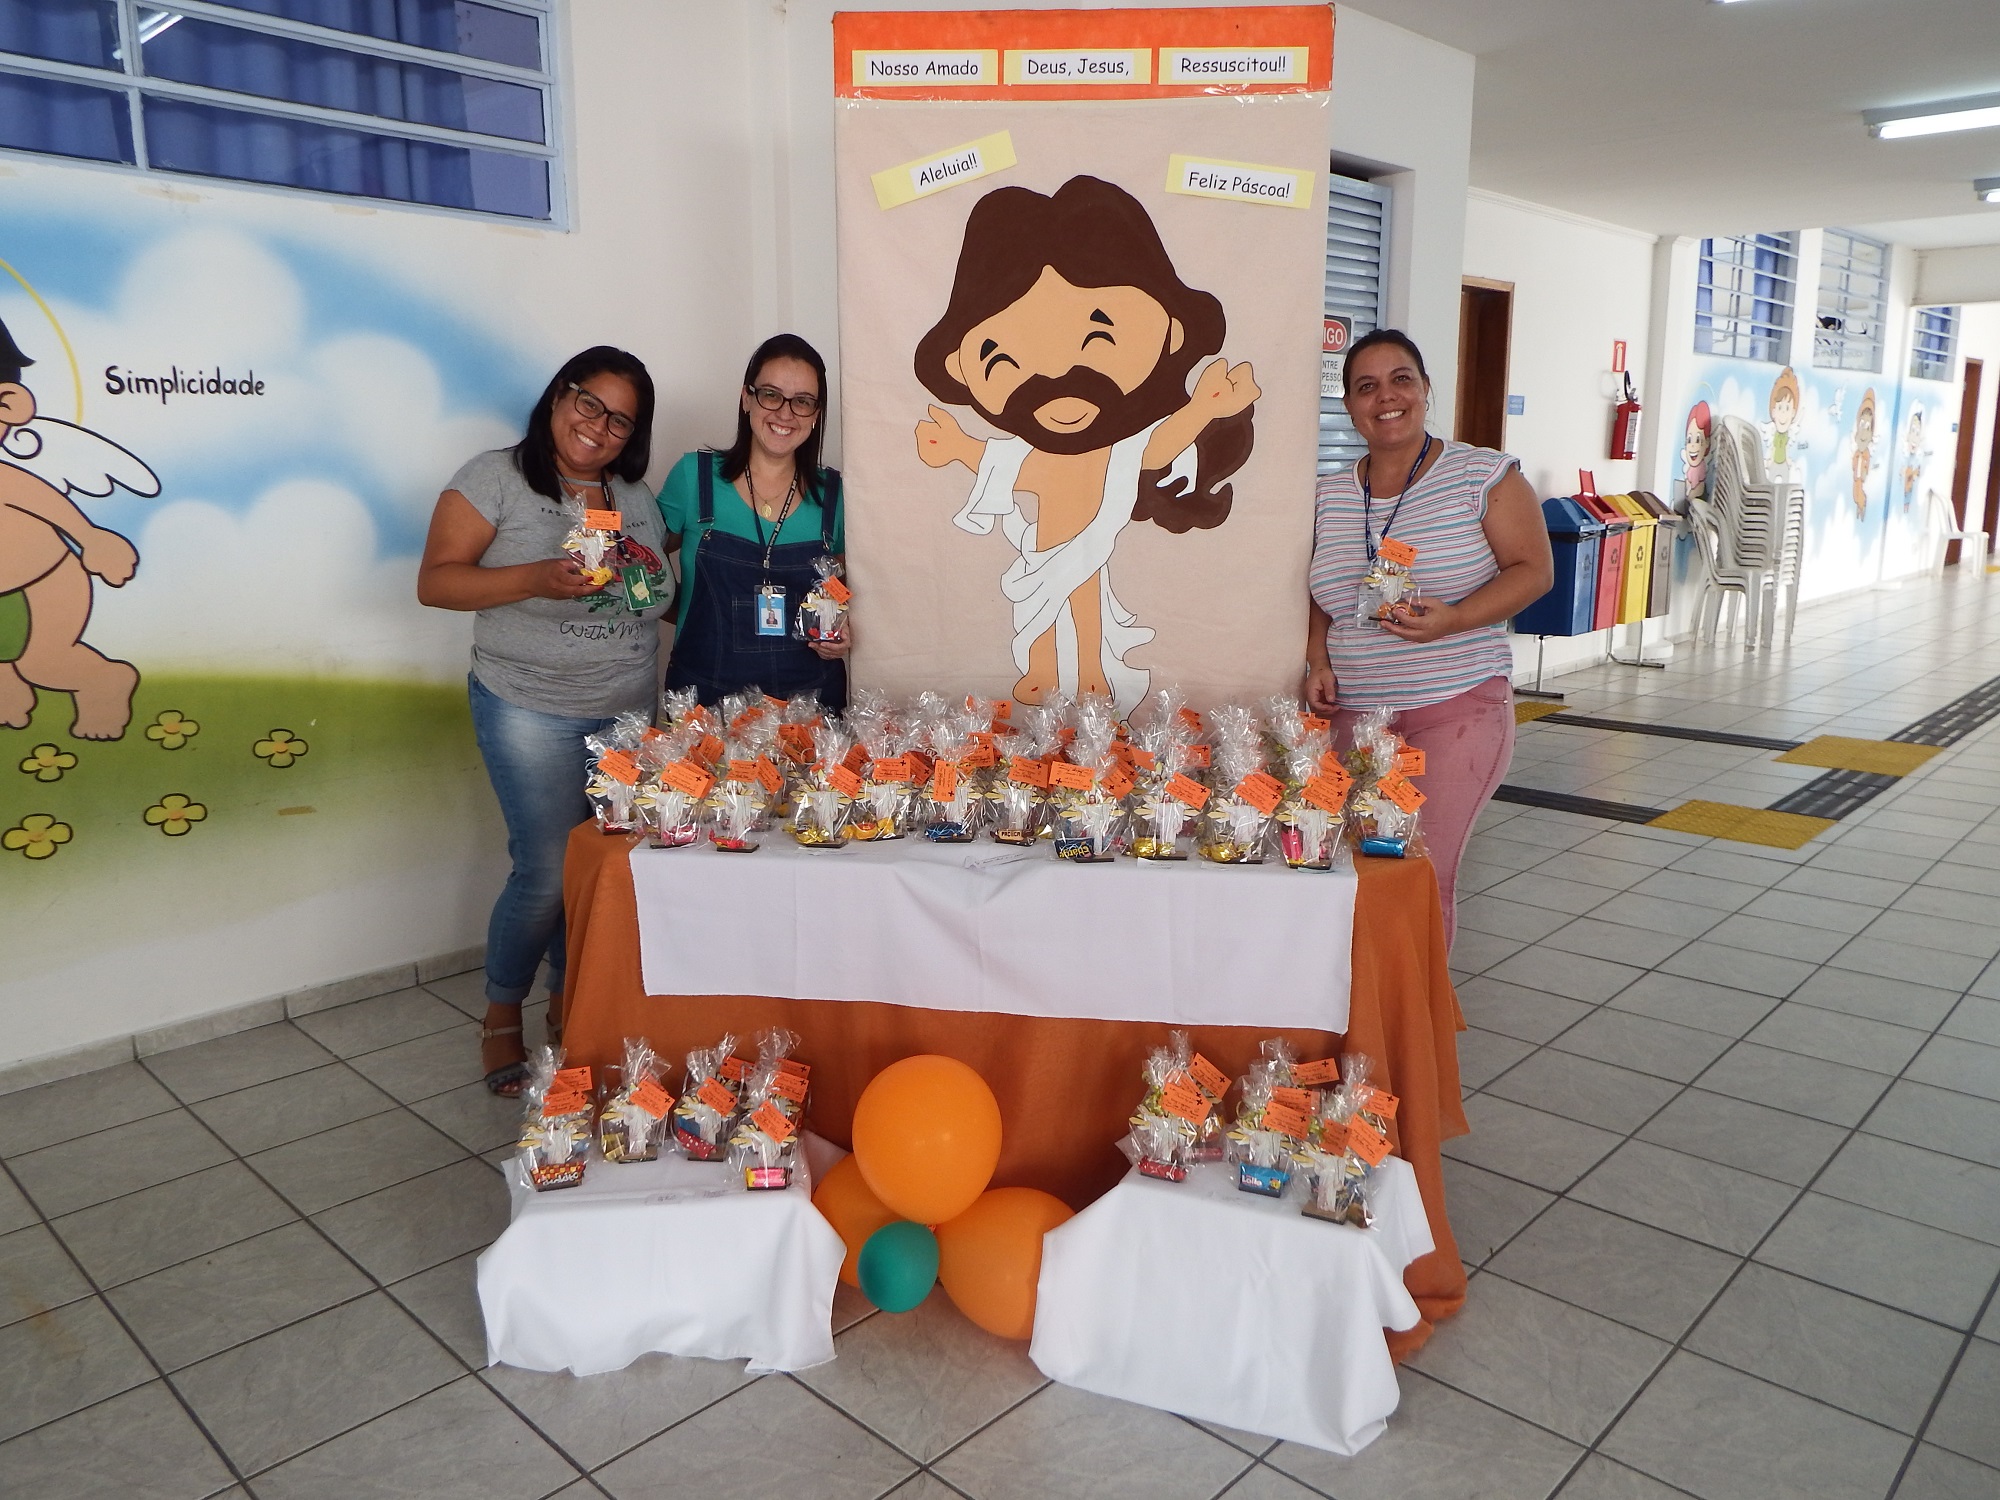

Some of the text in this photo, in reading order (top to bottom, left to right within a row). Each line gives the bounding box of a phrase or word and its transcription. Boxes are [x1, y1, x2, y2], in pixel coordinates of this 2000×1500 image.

[871, 60, 979, 76] Nosso Amado
[1027, 58, 1130, 77] Deus, Jesus,
[1180, 55, 1287, 74] Ressuscitou!!
[919, 153, 978, 186] Aleluia!!
[1188, 171, 1291, 199] Feliz Páscoa!
[1323, 327, 1343, 344] IGO
[1322, 361, 1338, 369] NTRE
[105, 365, 266, 405] Simplicidade
[1321, 372, 1341, 382] PESSO
